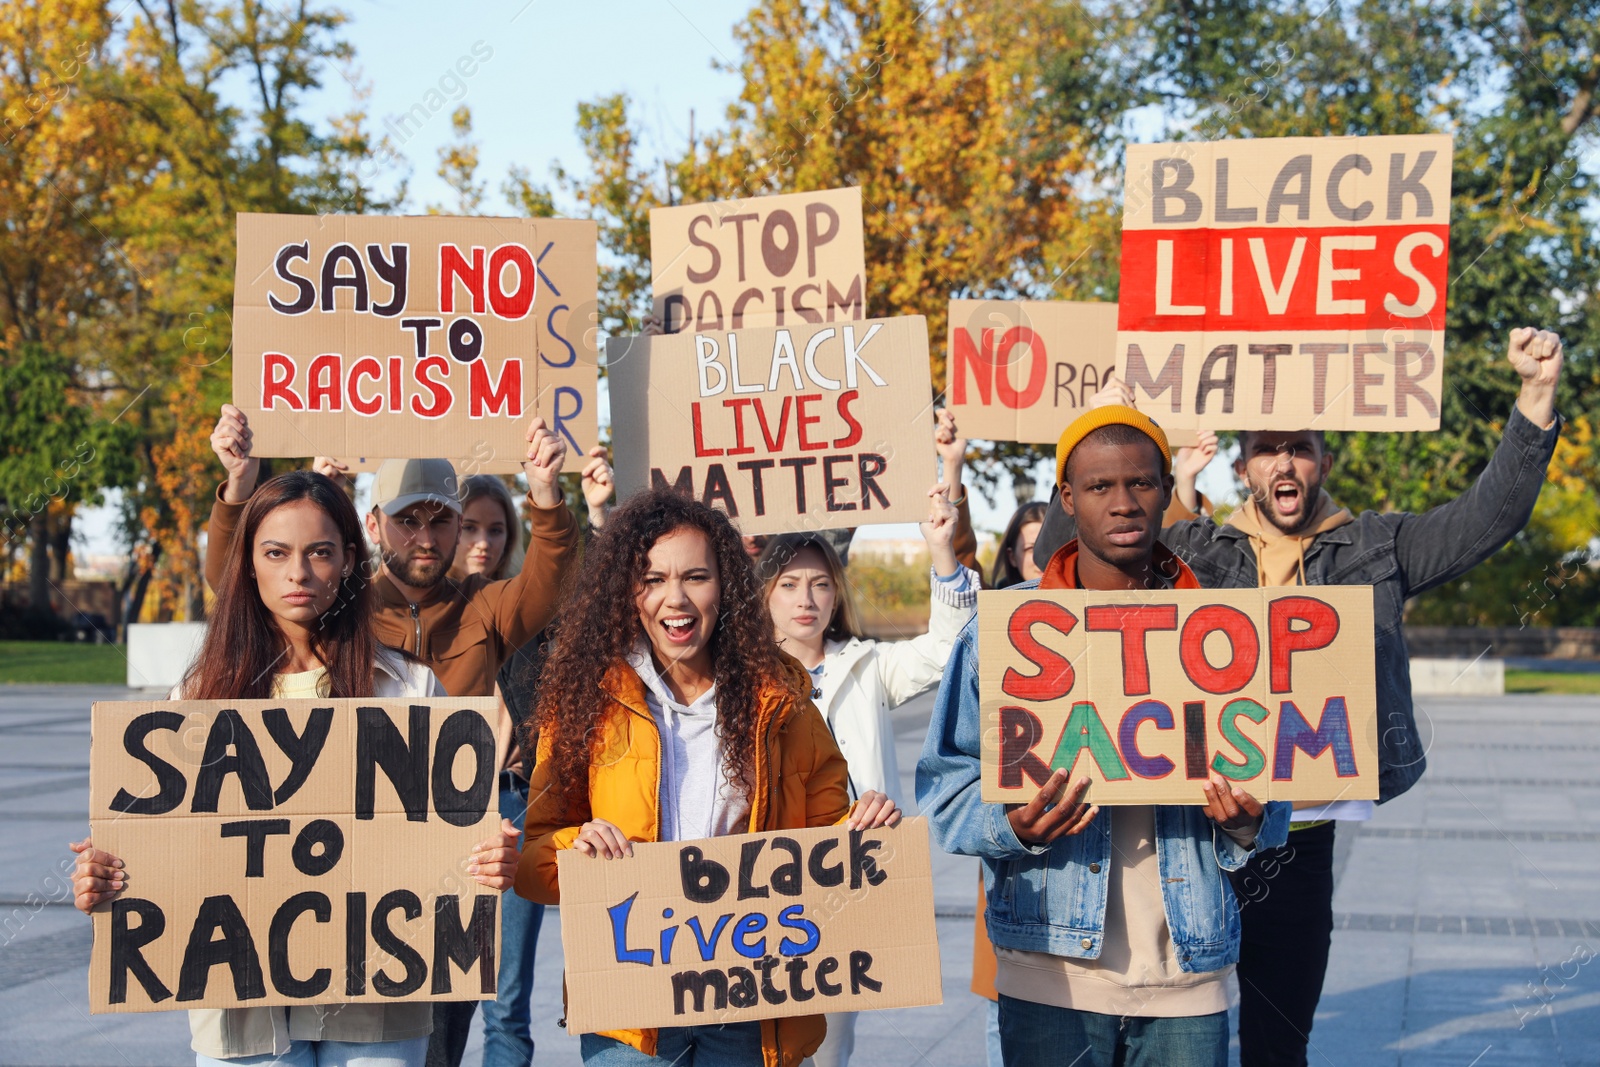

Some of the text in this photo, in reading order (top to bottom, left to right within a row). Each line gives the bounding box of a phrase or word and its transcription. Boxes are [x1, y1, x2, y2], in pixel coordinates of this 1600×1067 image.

[1151, 150, 1437, 224] BLACK
[267, 240, 537, 320] SAY NO
[686, 202, 840, 284] STOP
[1154, 231, 1445, 319] LIVES
[401, 318, 483, 364] TO
[695, 323, 889, 398] BLACK
[953, 326, 1047, 410] NO
[260, 352, 523, 419] RACISM
[1125, 342, 1439, 419] MATTER
[691, 389, 863, 459] LIVES
[650, 452, 891, 517] MATTER
[1001, 595, 1340, 702] STOP
[108, 705, 496, 828] SAY NO
[998, 696, 1360, 790] RACISM
[221, 818, 345, 878] TO
[108, 889, 498, 1005] RACISM
[607, 891, 821, 967] Lives
